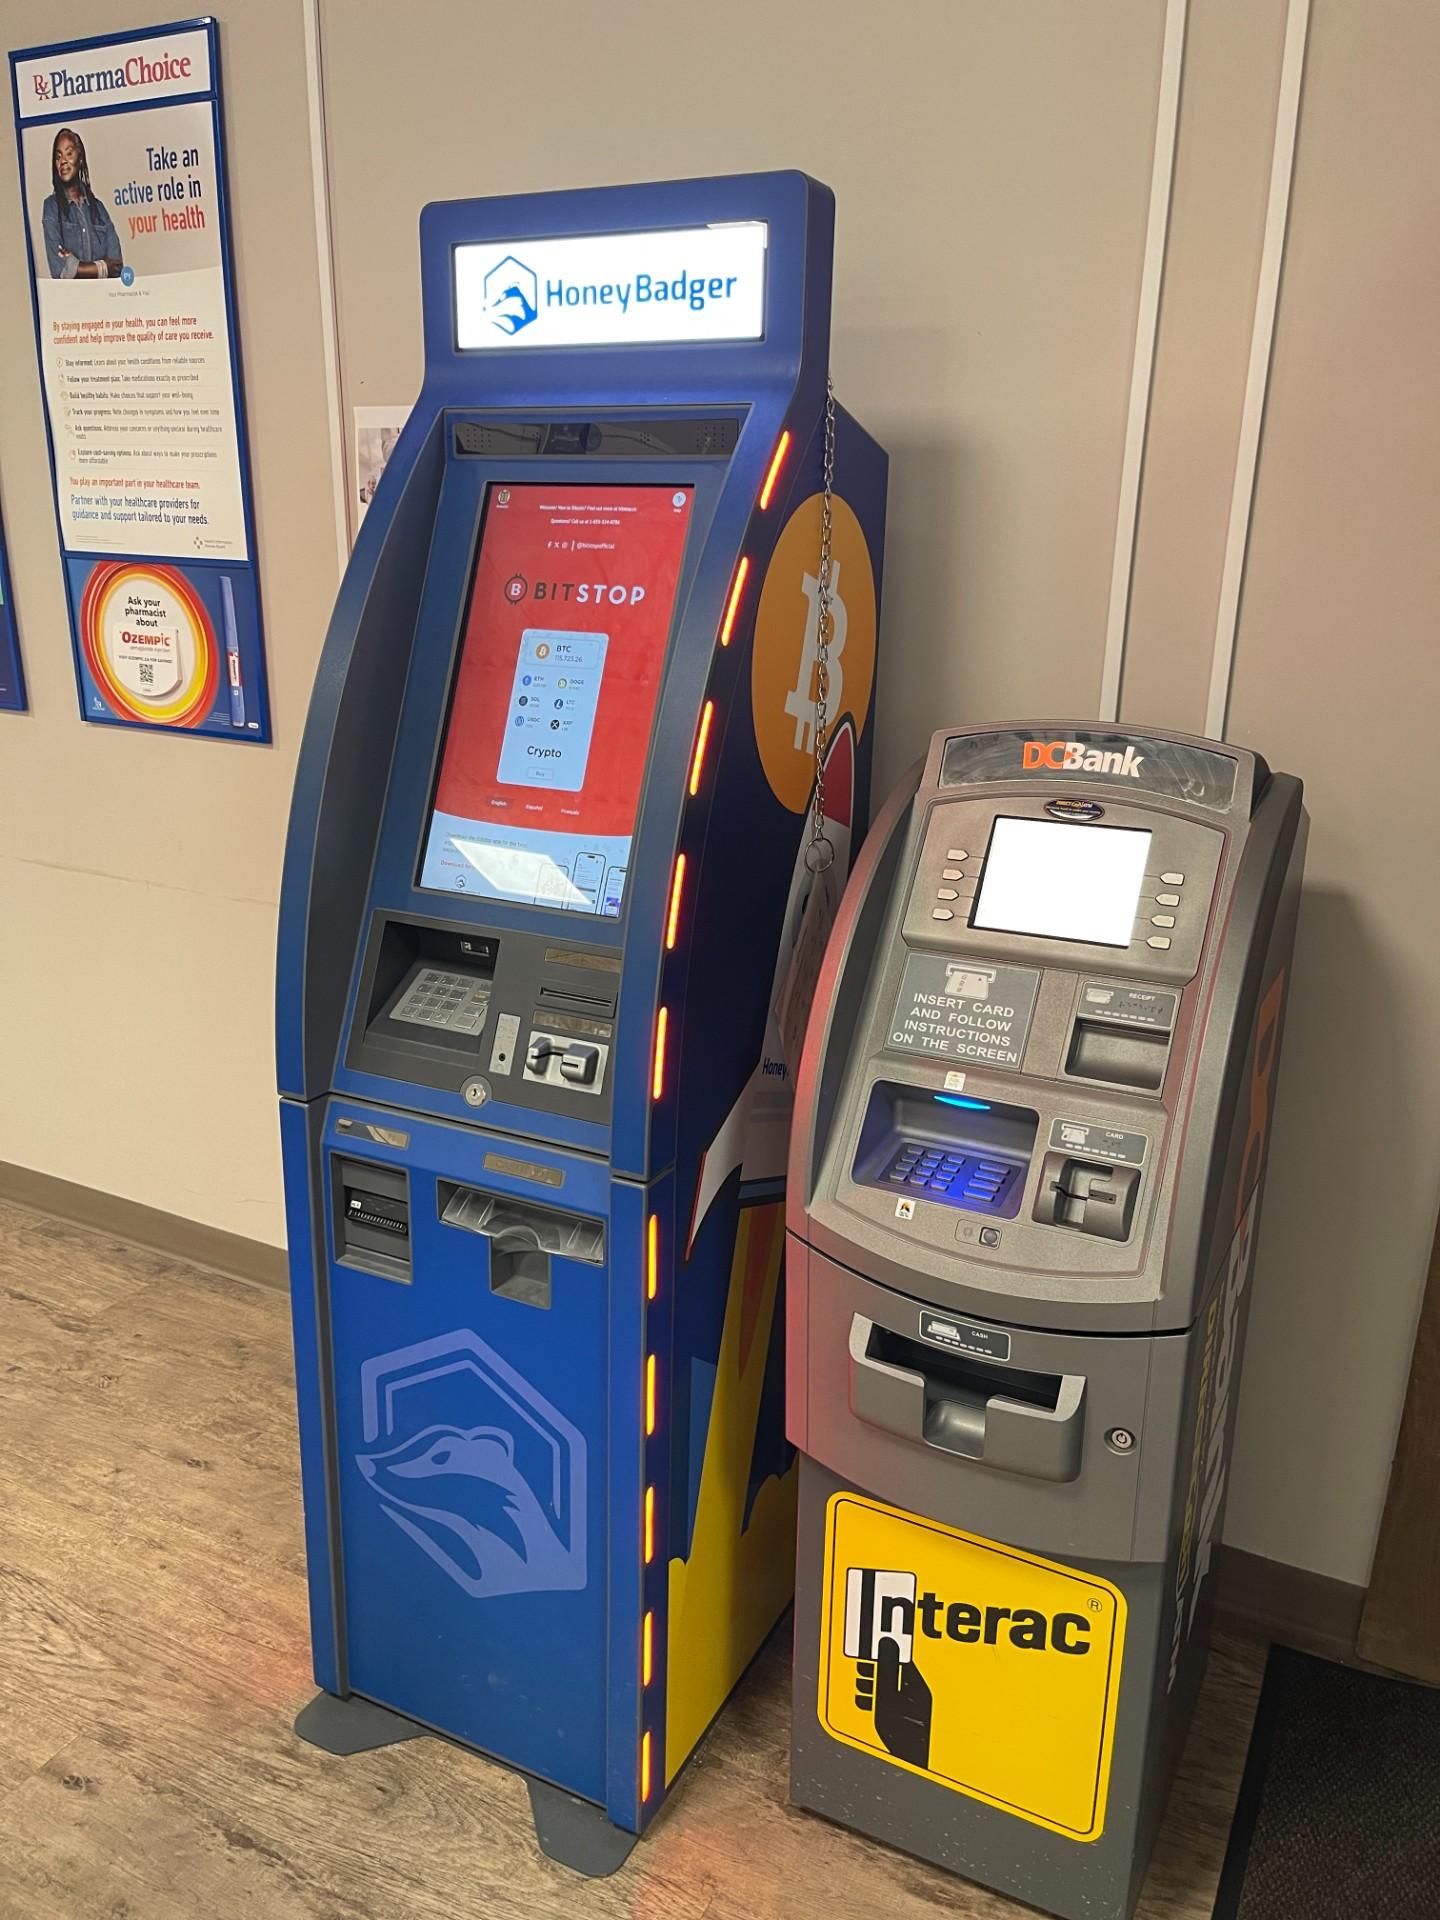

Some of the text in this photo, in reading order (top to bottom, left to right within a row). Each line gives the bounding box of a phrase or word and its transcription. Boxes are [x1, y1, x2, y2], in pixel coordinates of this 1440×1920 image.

[146, 147, 199, 172] Take an
[114, 174, 201, 206] active role in
[128, 205, 205, 239] your health
[547, 270, 737, 314] HoneyBadger
[54, 322, 60, 332] By
[62, 321, 80, 332] staying
[82, 320, 103, 331] engaged
[106, 320, 110, 328] in
[112, 321, 123, 330] your
[126, 318, 145, 329] health,
[146, 320, 156, 328] you
[169, 317, 180, 326] feel
[54, 335, 78, 344] confident
[80, 334, 90, 343] and
[91, 334, 101, 344] help
[105, 333, 125, 344] improve
[127, 333, 136, 341] the
[137, 332, 155, 343] quality
[158, 332, 163, 340] of
[180, 333, 189, 341] you
[191, 330, 214, 339] receive.
[81, 478, 90, 487] play
[100, 479, 124, 488] important
[126, 479, 135, 488] part
[144, 481, 154, 489] your
[157, 480, 184, 488] healthcare
[186, 481, 201, 489] team.
[71, 495, 199, 511] Partner with your healthcare providers for
[72, 508, 209, 525] guidance and support tailored to your needs.
[534, 582, 645, 605] BITSTOP
[128, 596, 160, 608] Ask your
[125, 607, 166, 618] pharmacist
[136, 618, 158, 627] about
[557, 645, 571, 653] BTC
[527, 745, 562, 758] Crypto
[1022, 741, 1145, 778] DCBank
[491, 799, 507, 807] English
[1129, 992, 1156, 1002] RECEIPT
[913, 992, 1014, 1018] INSERT CARD
[910, 1006, 1012, 1032] AND FOLLOW
[904, 1019, 1011, 1047] INSTRUCTIONS
[892, 1031, 1017, 1063] ON THE SCREEN
[1106, 1131, 1124, 1140] CARD
[971, 1330, 988, 1340] CASH
